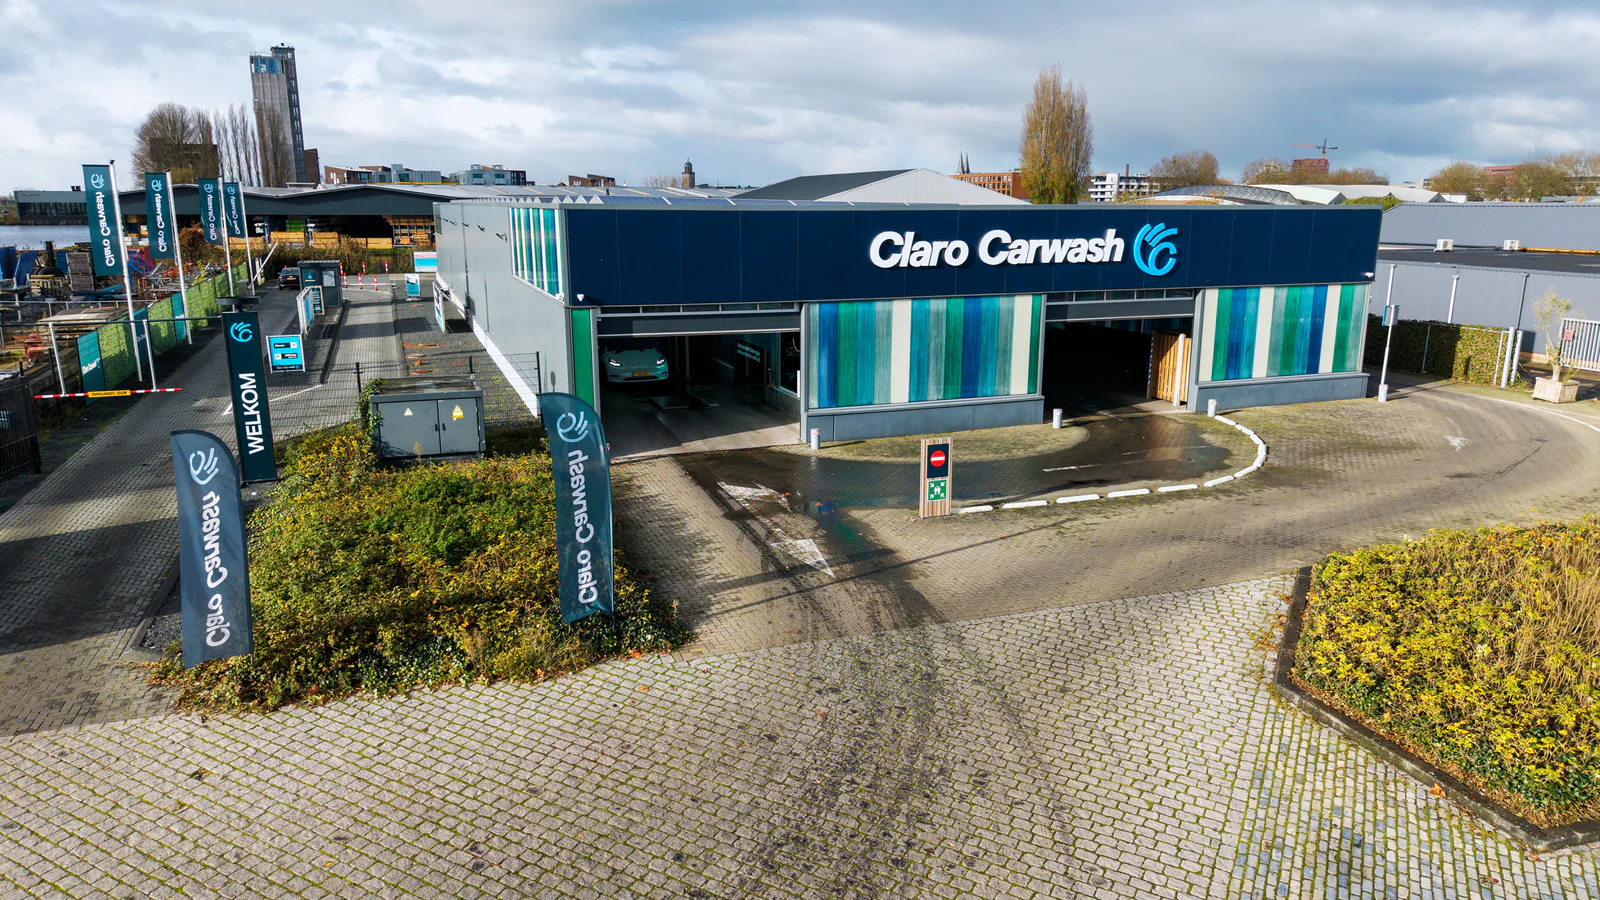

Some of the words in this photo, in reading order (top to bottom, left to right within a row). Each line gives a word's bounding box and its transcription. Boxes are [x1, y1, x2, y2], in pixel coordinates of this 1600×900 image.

[869, 230, 970, 269] Claro
[978, 228, 1125, 266] Carwash
[238, 372, 265, 455] WELKOM
